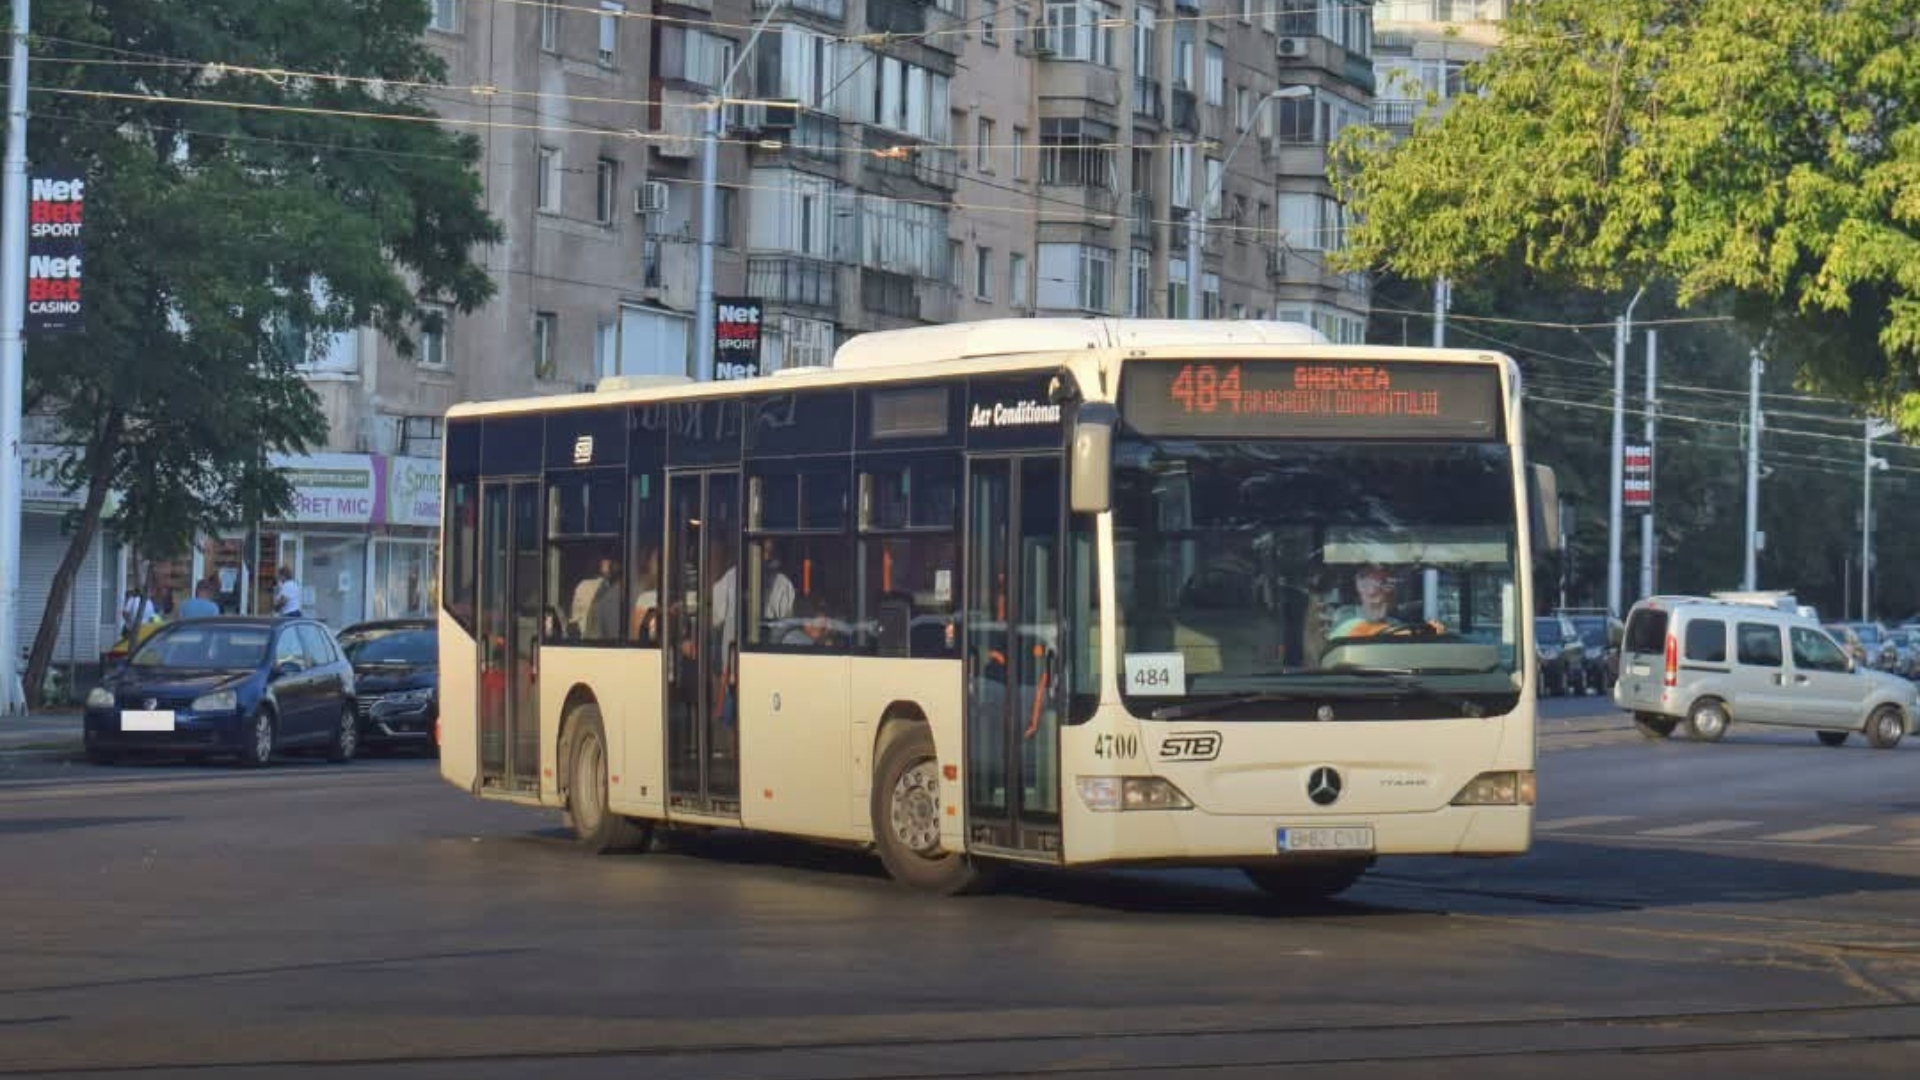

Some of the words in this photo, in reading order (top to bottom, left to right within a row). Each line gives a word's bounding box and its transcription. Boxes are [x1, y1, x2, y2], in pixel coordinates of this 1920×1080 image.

[32, 178, 84, 201] Net
[31, 201, 84, 222] Bet
[31, 223, 82, 237] SPORT
[29, 255, 82, 278] Net
[28, 278, 81, 300] Bet
[29, 301, 80, 314] CASINO
[719, 304, 760, 323] Net
[718, 338, 757, 349] SPORT
[716, 361, 757, 379] Net
[1171, 364, 1240, 414] 484
[969, 402, 992, 427] Aer
[337, 497, 369, 515] MIC
[1134, 668, 1170, 686] 484
[1095, 733, 1137, 759] 4700
[1159, 737, 1216, 756] STB
